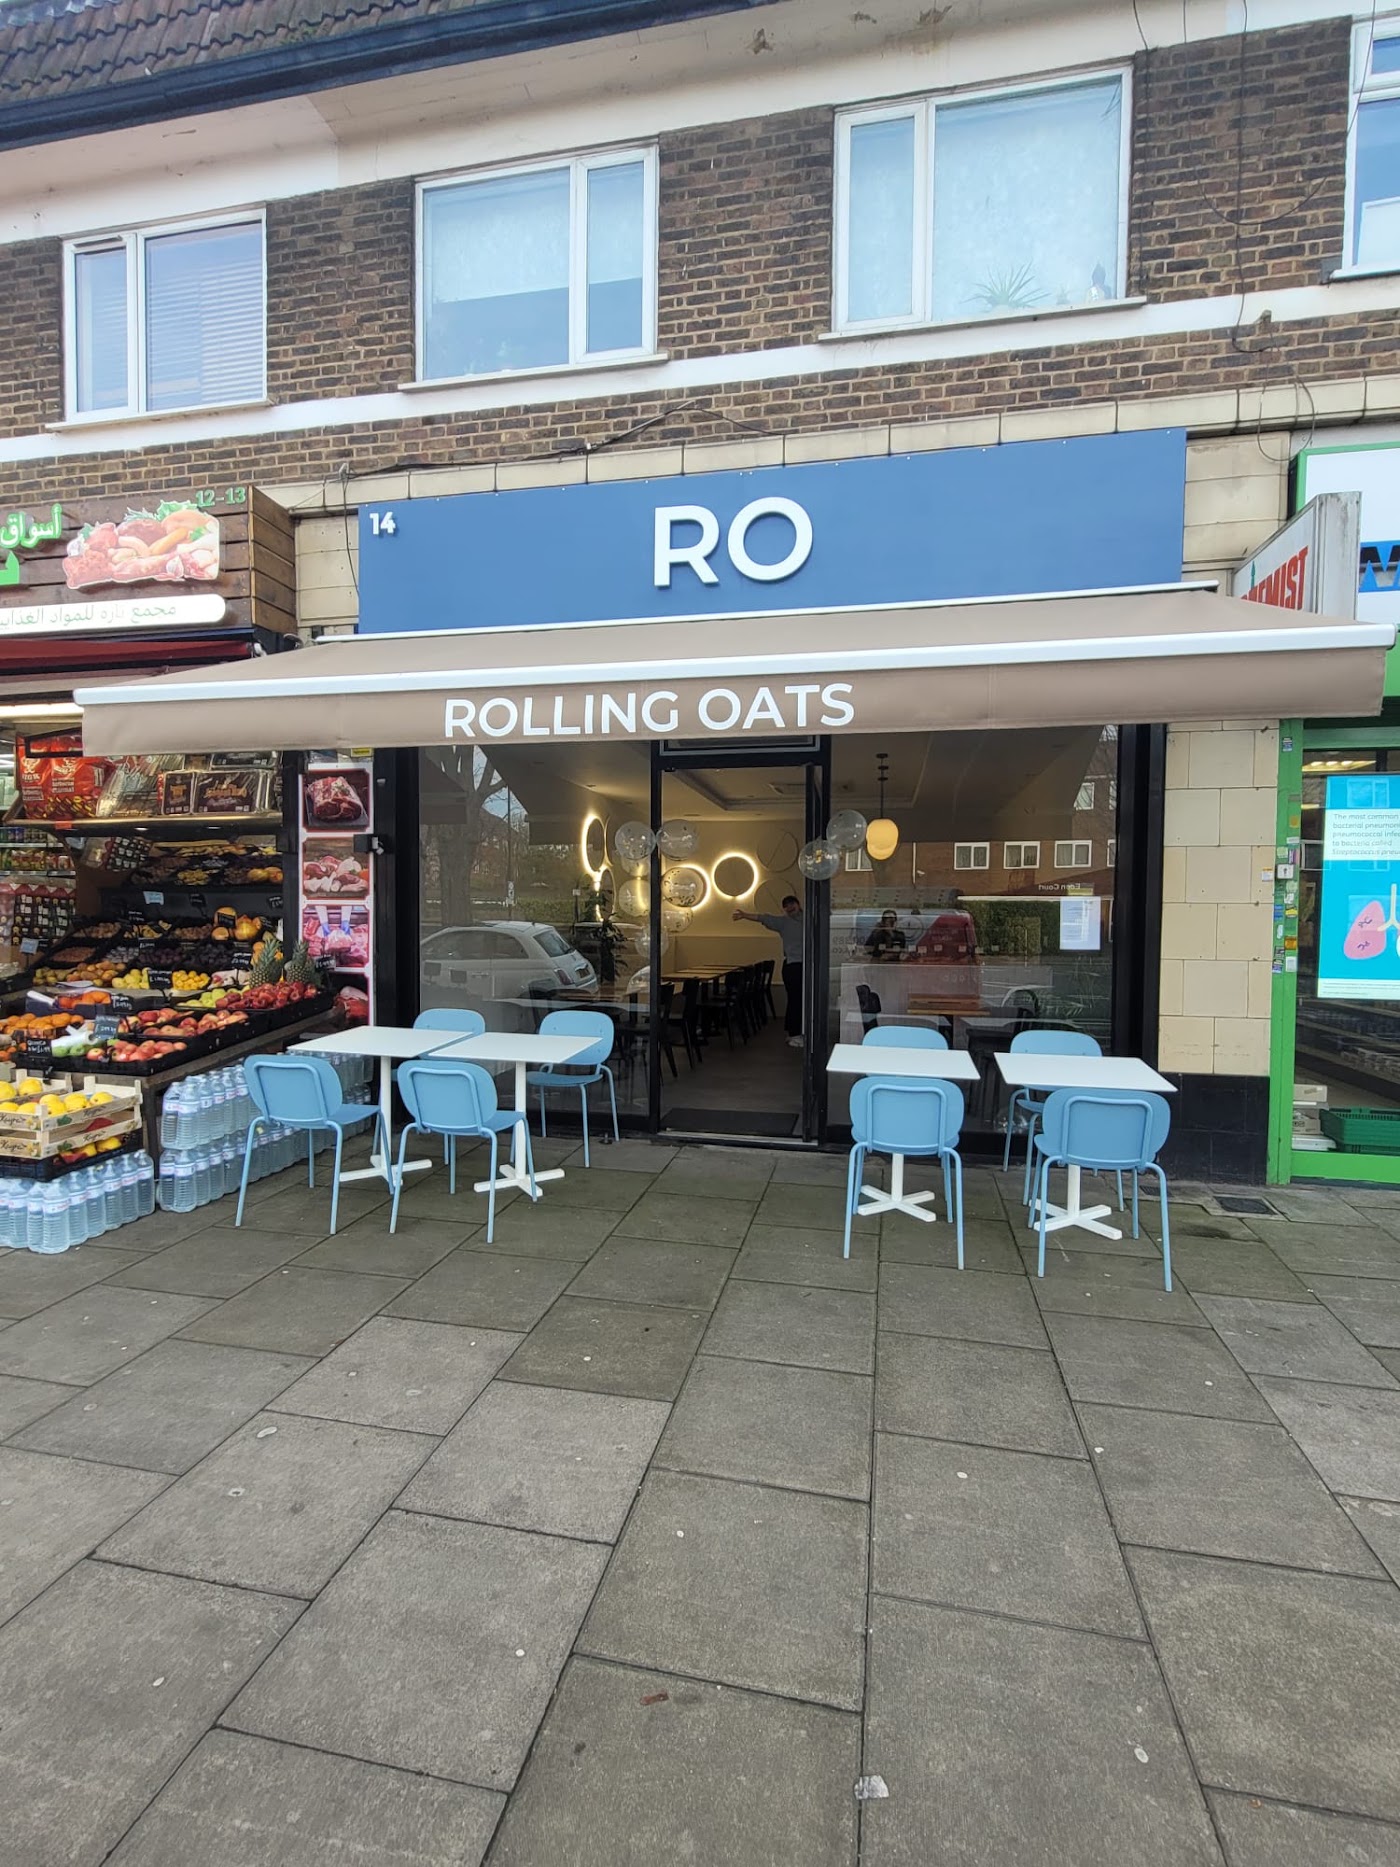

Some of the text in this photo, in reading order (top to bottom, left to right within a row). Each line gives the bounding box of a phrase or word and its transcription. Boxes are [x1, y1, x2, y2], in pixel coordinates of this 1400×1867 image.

[195, 487, 246, 508] 12-13
[0, 503, 62, 548] أسواق
[369, 511, 396, 536] 14
[653, 496, 814, 588] RO
[1240, 545, 1309, 611] MIST
[131, 606, 176, 624] مجمع
[445, 682, 856, 738] ROLLING OATS
[1332, 821, 1364, 829] bacterial
[1332, 830, 1383, 838] pneumococcal
